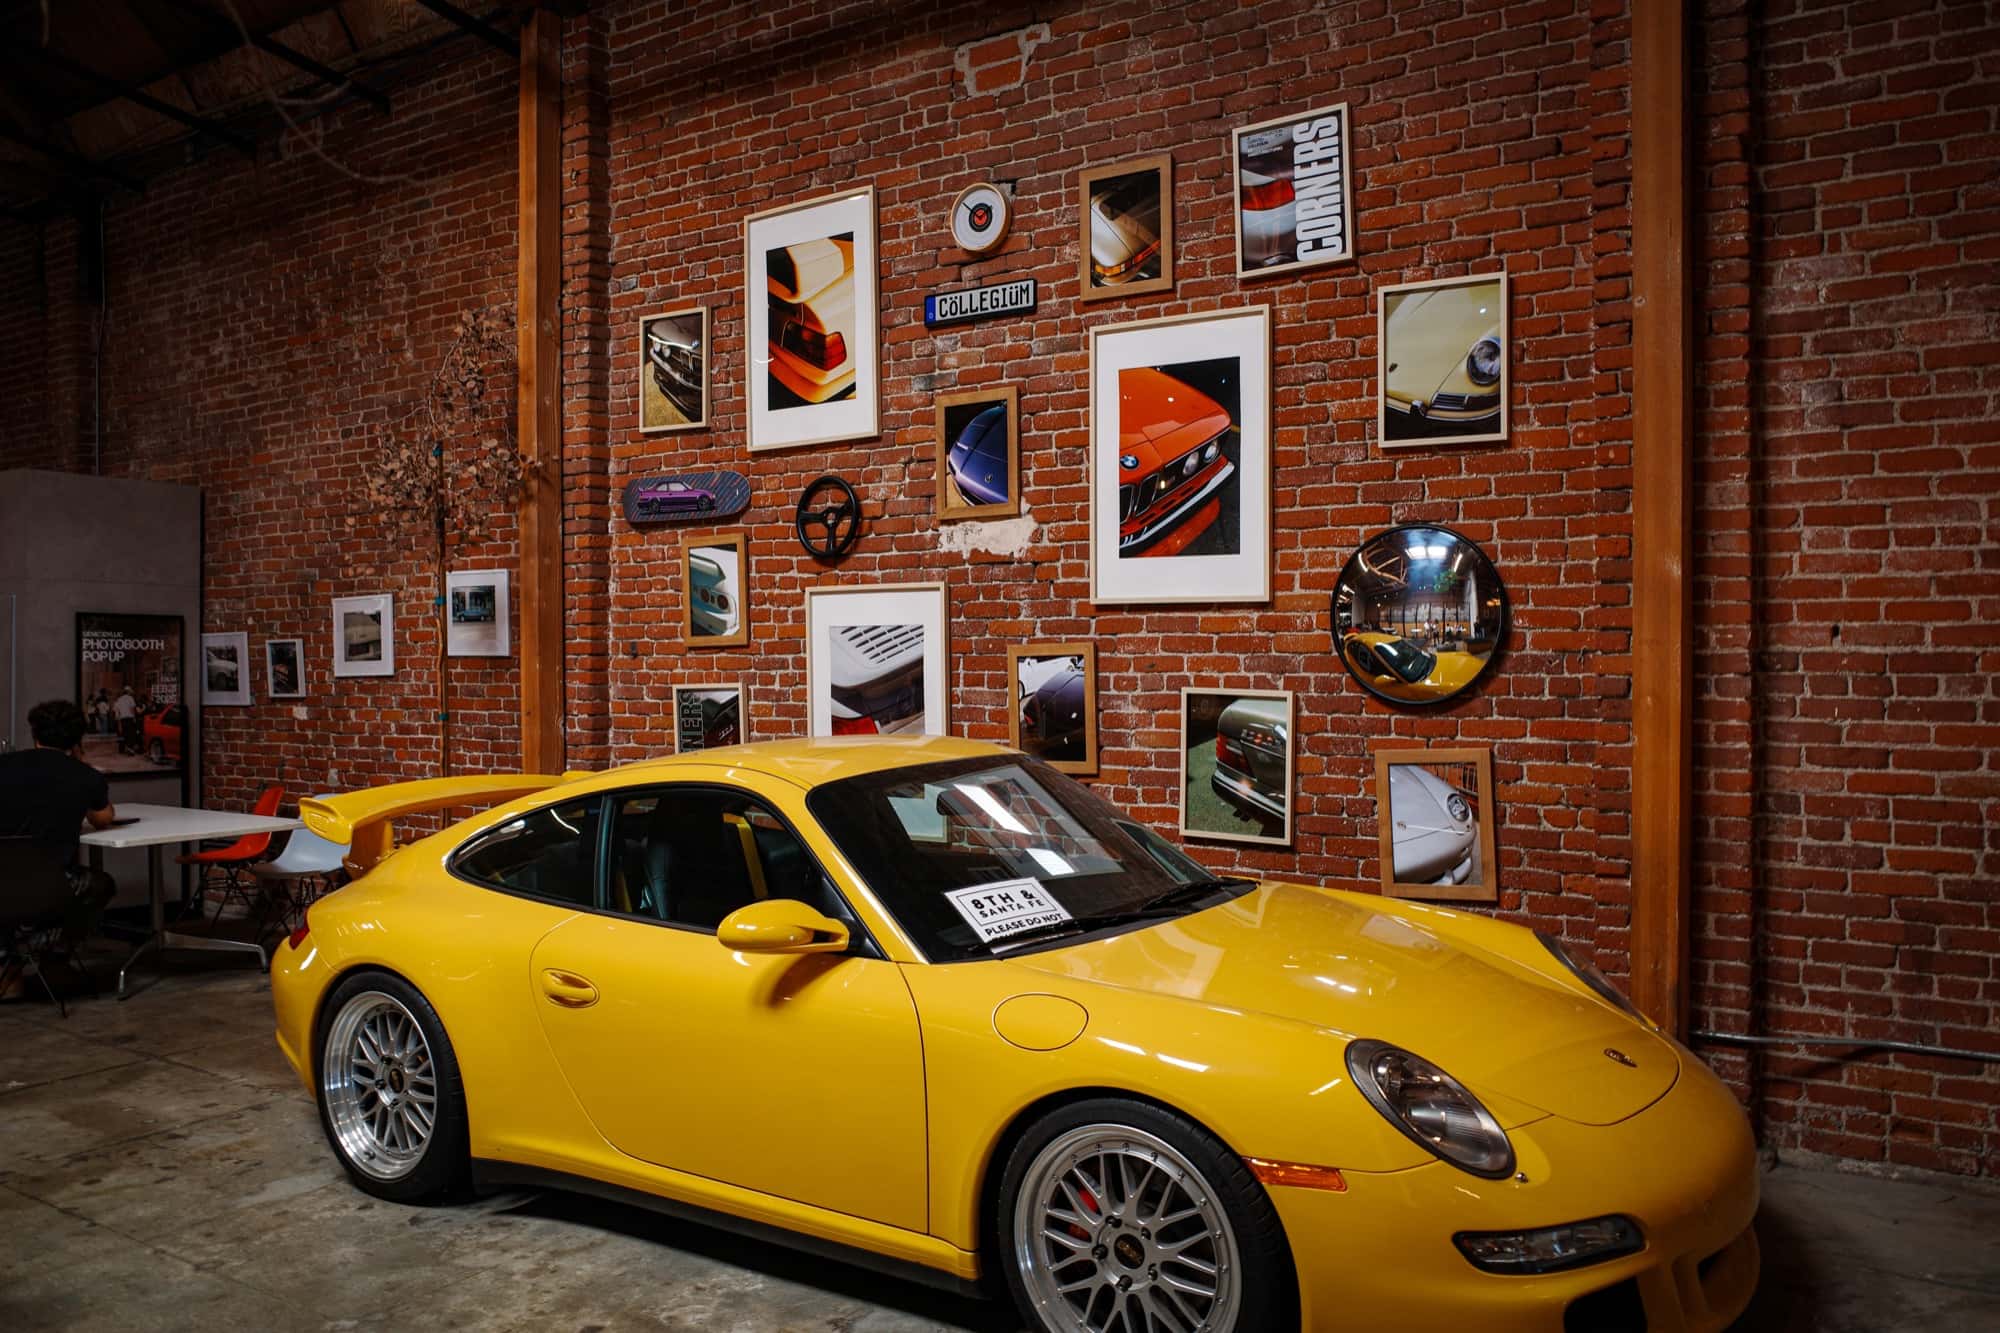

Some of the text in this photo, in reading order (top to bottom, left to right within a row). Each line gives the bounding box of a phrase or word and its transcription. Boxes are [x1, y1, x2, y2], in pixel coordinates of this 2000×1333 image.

[1292, 115, 1343, 262] CORNERS
[82, 638, 165, 650] PHOTOBOOTH
[971, 889, 1037, 910] 8TH &
[979, 899, 1045, 918] SANTA FE
[985, 913, 1063, 936] PLEASE DO NOT
